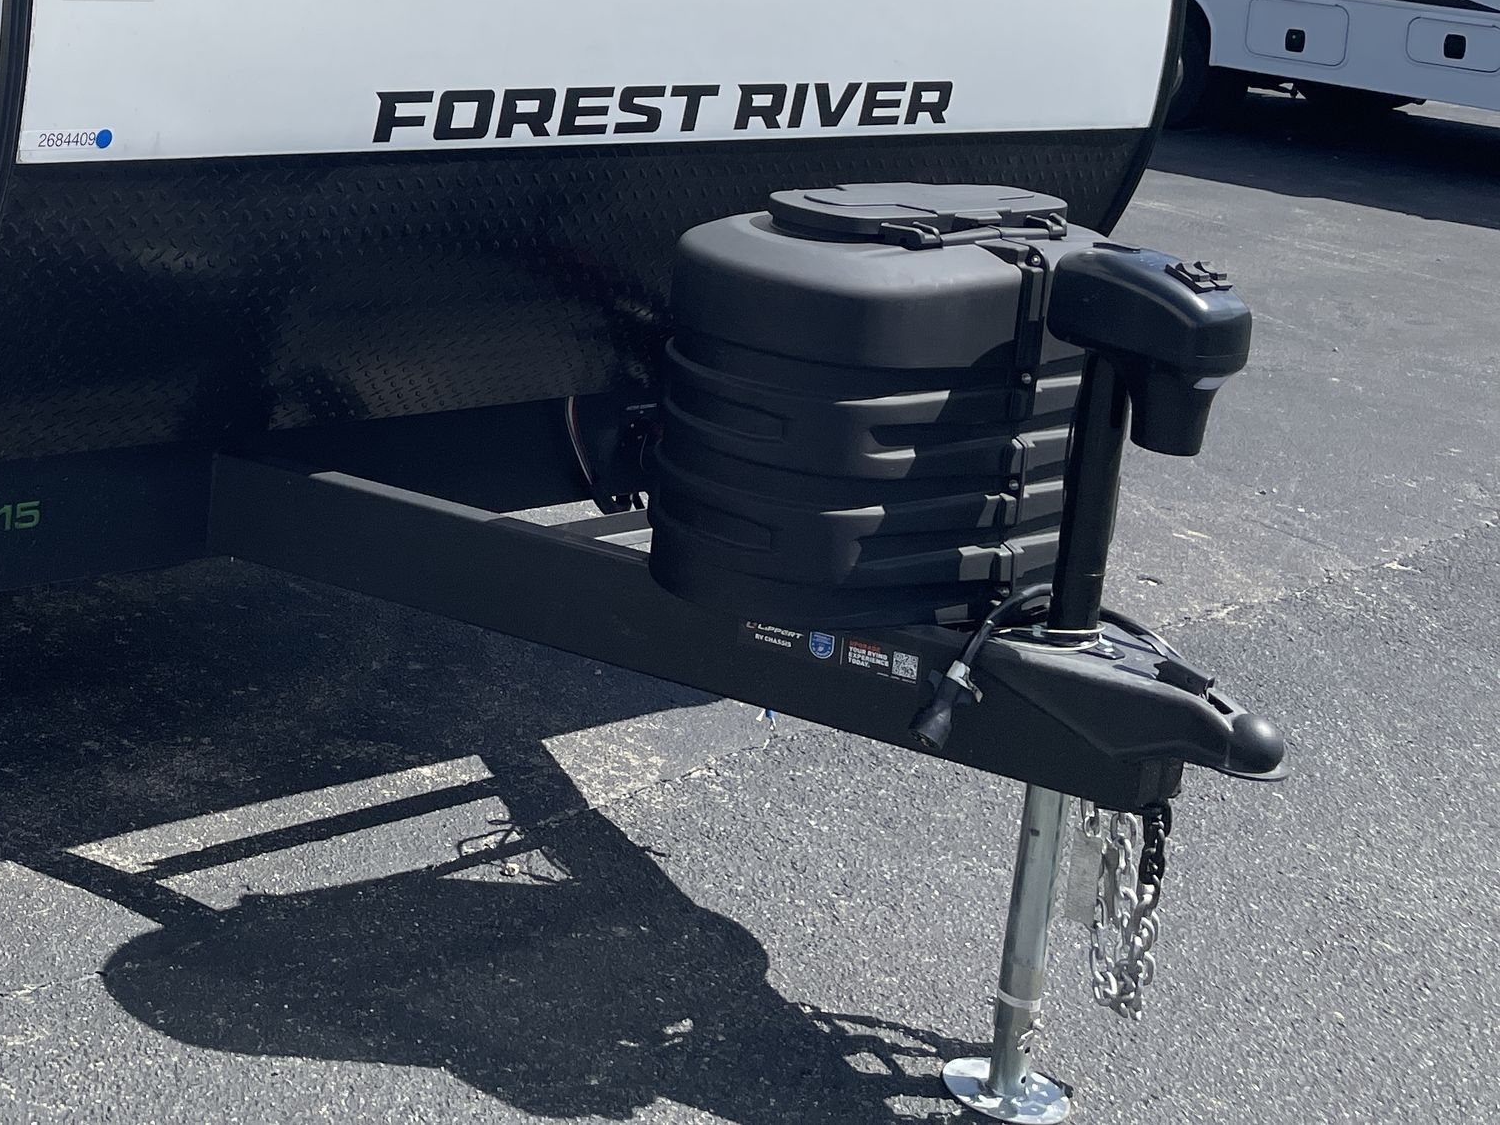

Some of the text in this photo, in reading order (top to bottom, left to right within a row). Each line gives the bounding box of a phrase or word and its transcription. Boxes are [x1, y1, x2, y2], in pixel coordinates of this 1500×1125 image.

[372, 81, 953, 144] FOREST RIVER
[38, 131, 96, 149] 2684409
[764, 635, 792, 648] CHASSIS
[848, 646, 866, 655] YOUR
[848, 651, 889, 668] EXPERIENCE
